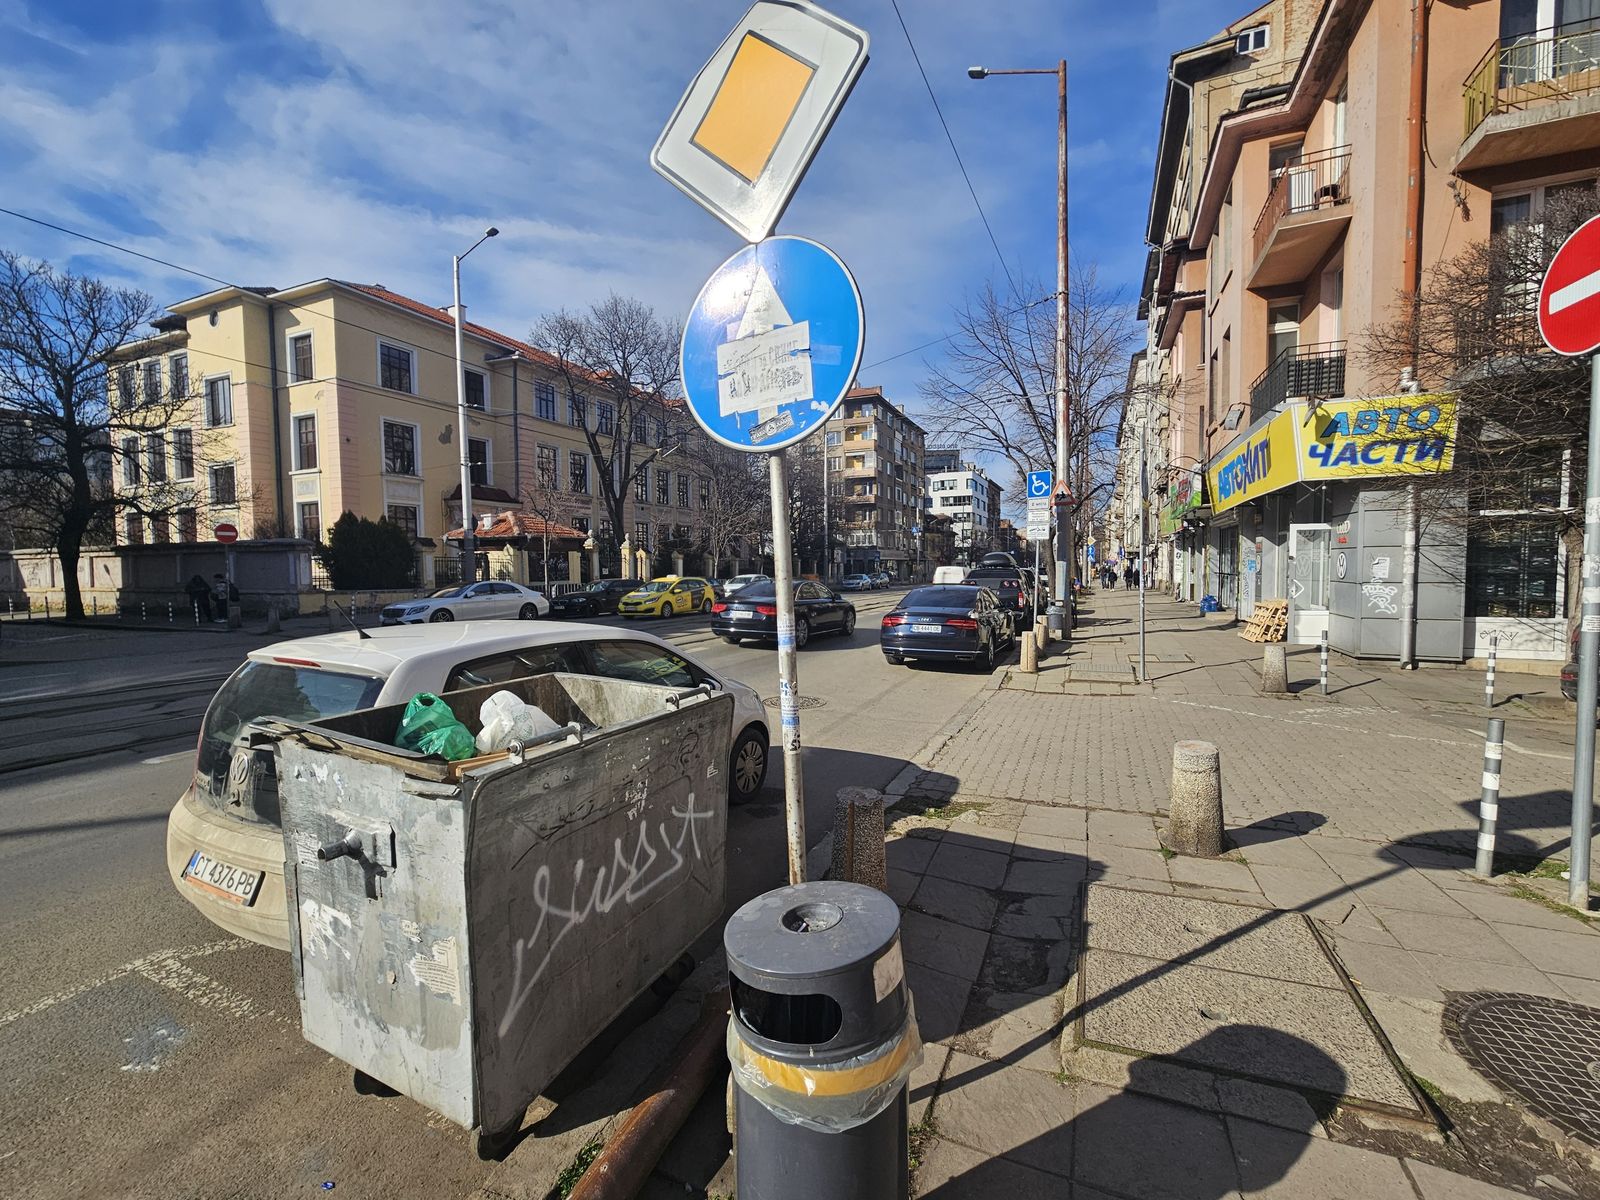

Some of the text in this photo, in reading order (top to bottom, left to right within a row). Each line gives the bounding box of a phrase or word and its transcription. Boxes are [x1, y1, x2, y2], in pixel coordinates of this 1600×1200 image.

[1320, 405, 1440, 438] АВТО
[1308, 439, 1448, 467] ЧАСТИ
[209, 862, 238, 889] 4376
